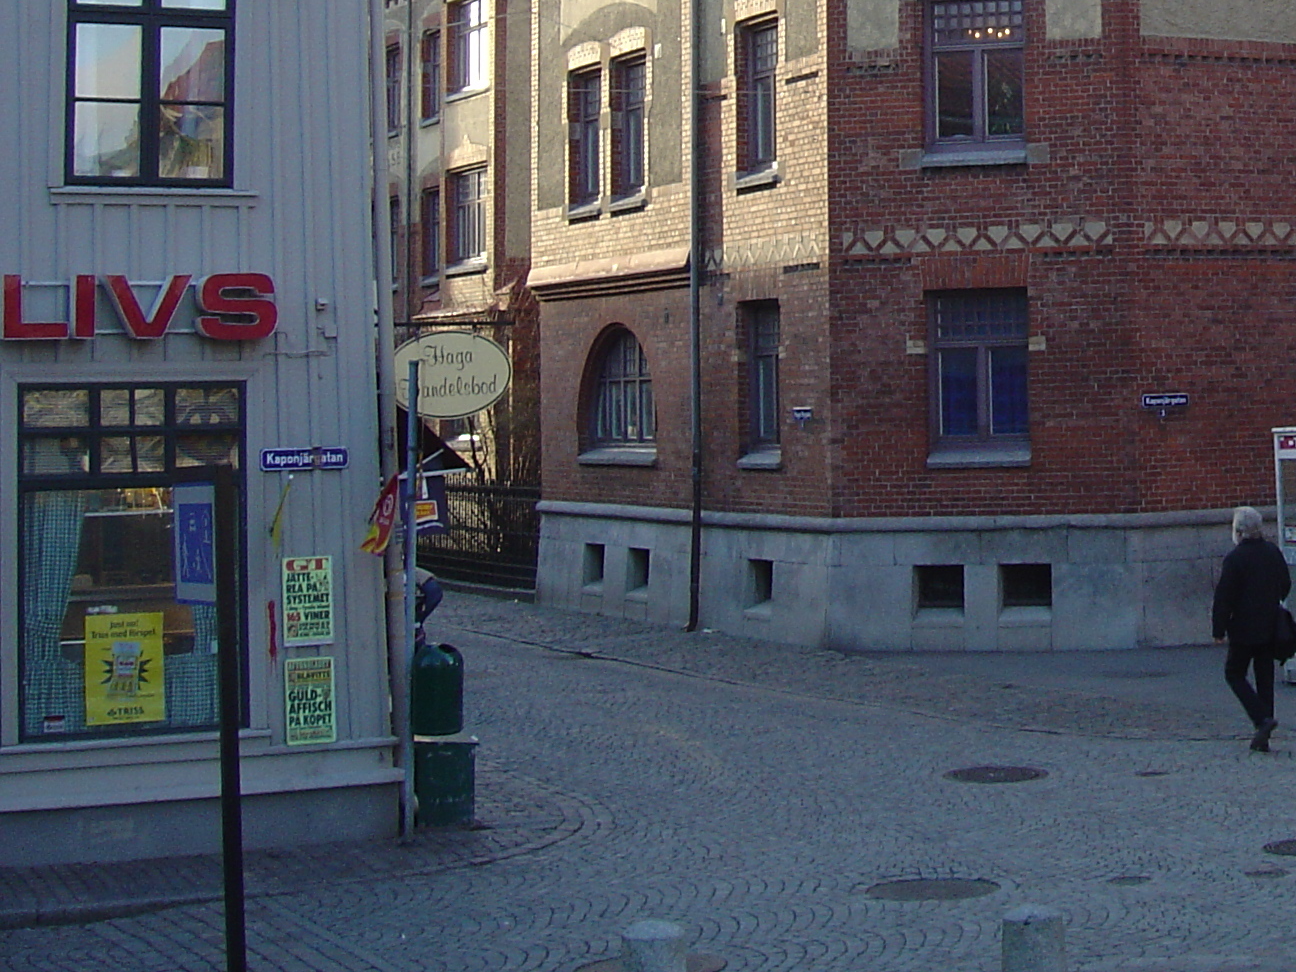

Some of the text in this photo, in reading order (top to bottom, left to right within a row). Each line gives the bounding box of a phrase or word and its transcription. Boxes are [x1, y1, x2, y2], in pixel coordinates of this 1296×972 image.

[2, 272, 278, 341] LIVS
[422, 344, 473, 370] Haga
[400, 373, 497, 399] andelsbod
[286, 558, 330, 571] GT
[286, 593, 330, 605] SYSTEMET
[303, 610, 330, 621] VINER
[288, 688, 321, 702] GULD-
[119, 706, 145, 716] TRISS
[288, 700, 332, 715] AFFISCH
